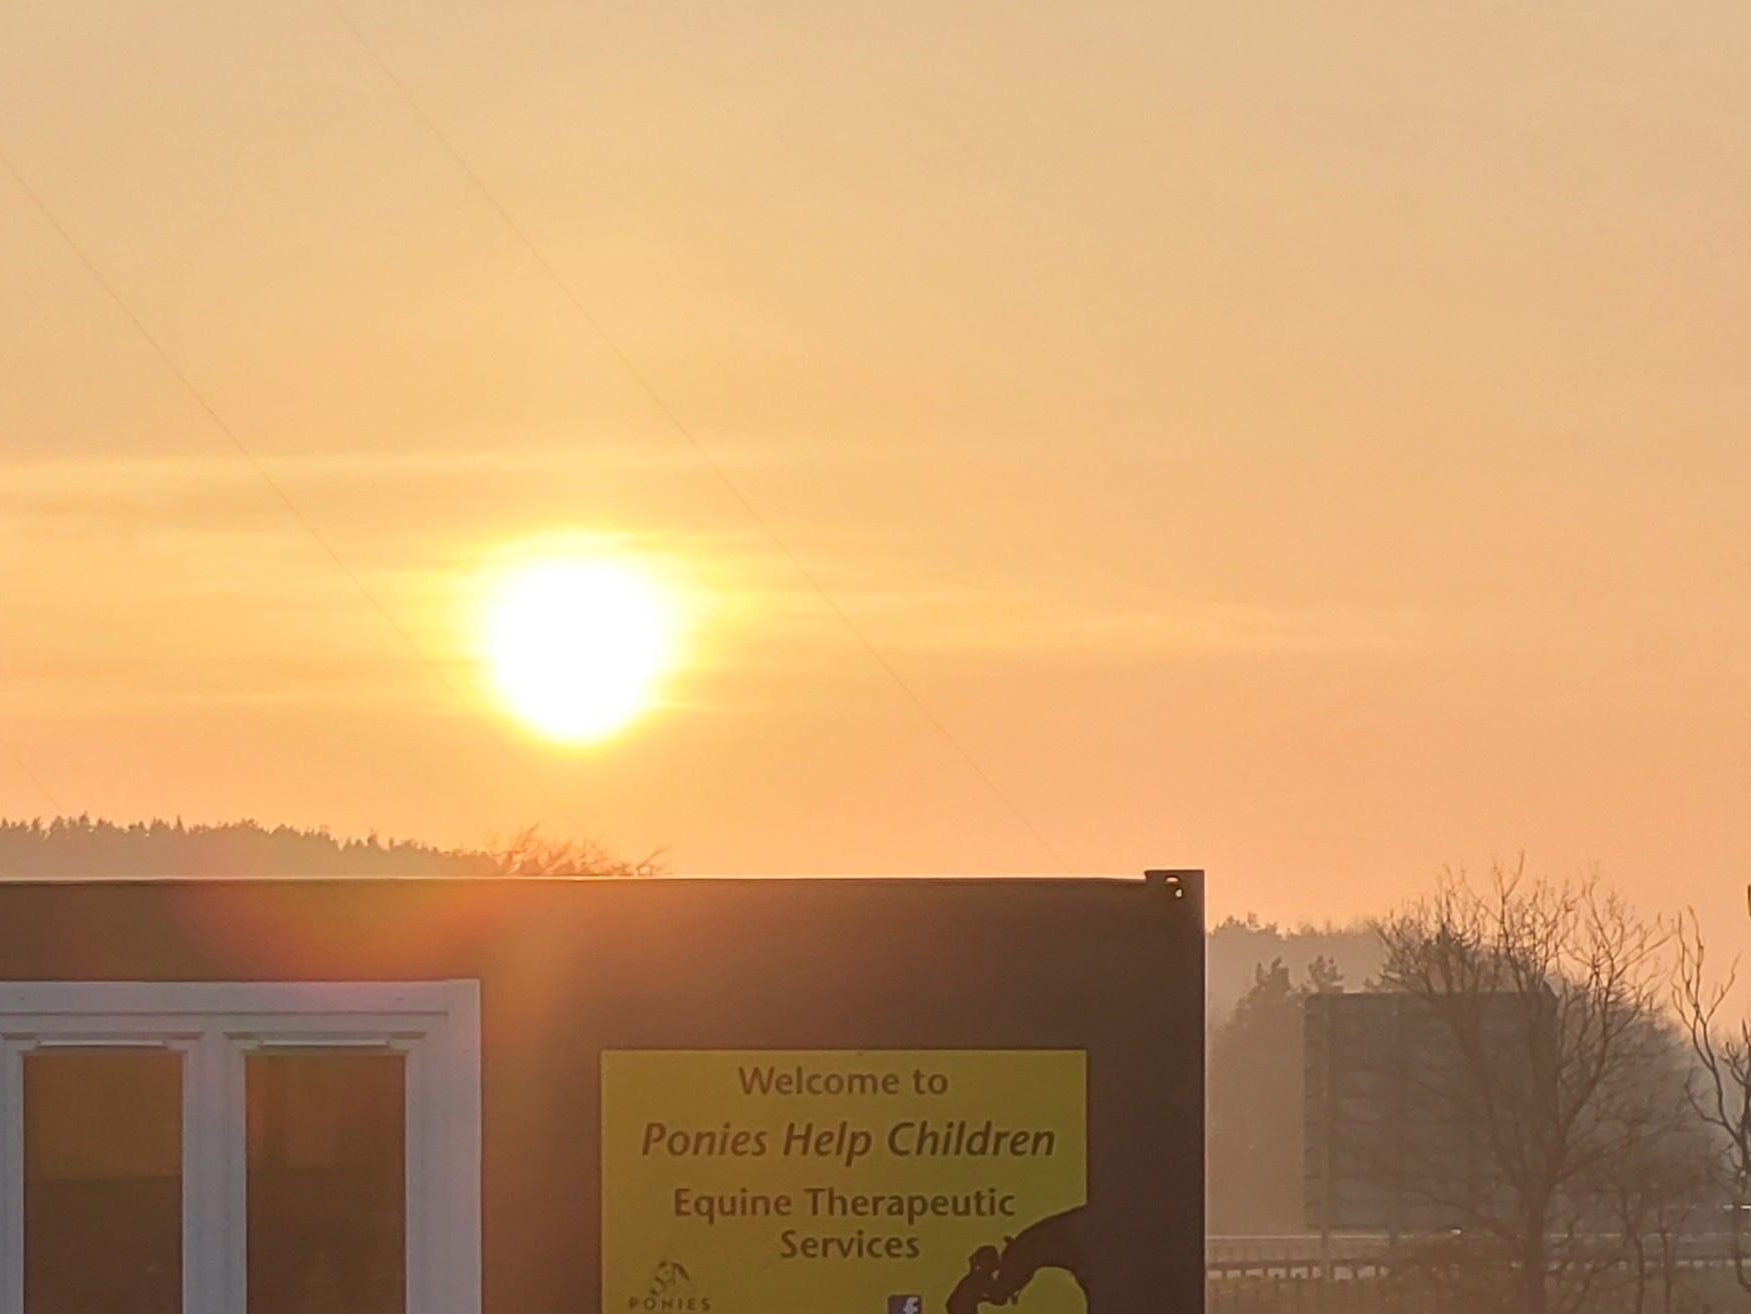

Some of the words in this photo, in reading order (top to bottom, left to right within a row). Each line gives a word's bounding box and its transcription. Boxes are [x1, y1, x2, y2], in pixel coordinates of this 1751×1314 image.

[738, 1065, 900, 1096] Welcome
[912, 1068, 949, 1096] to
[641, 1121, 768, 1158] Ponies
[782, 1121, 873, 1167] Help
[887, 1120, 1056, 1158] Children
[673, 1188, 793, 1225] Equine
[804, 1187, 1017, 1225] Therapeutic
[779, 1230, 921, 1260] Services
[628, 1296, 712, 1312] PONIES
